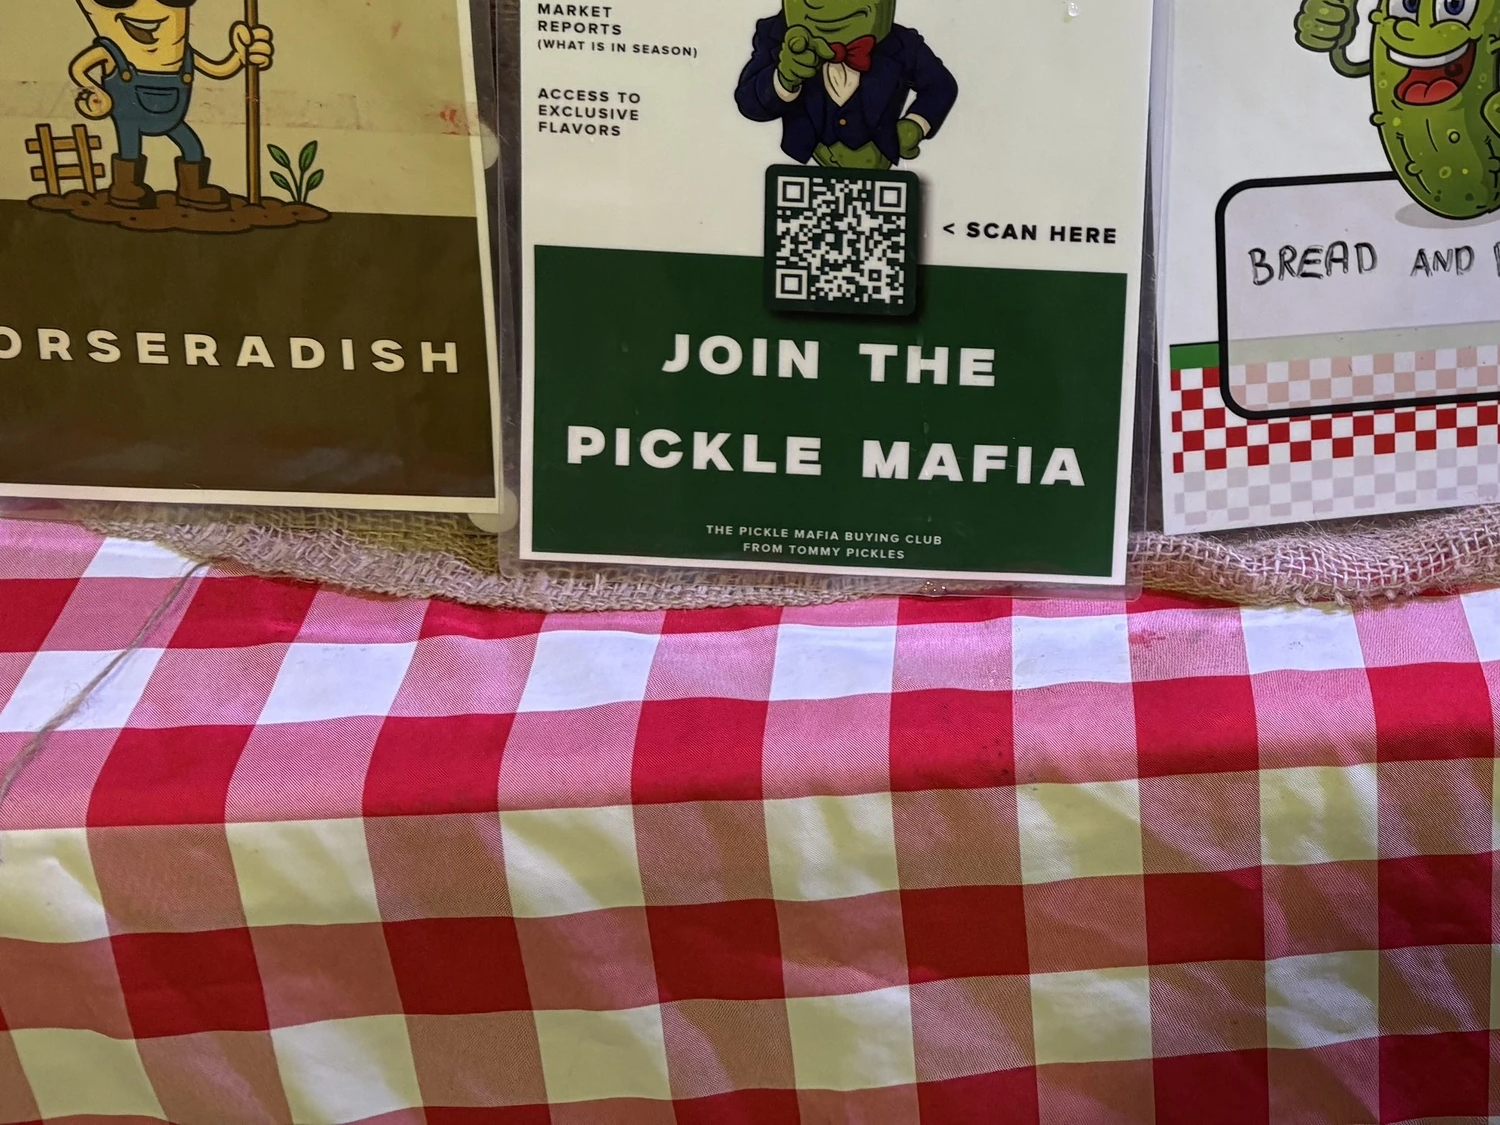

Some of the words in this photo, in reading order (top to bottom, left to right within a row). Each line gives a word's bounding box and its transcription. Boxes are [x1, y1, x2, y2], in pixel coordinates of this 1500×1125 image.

[537, 2, 613, 18] MARKET
[537, 19, 623, 36] REPORTS
[537, 38, 586, 51] (WHAT
[591, 41, 606, 52] IS
[611, 42, 627, 53] IN
[632, 43, 698, 59] SEASON)
[537, 87, 610, 103] ACCESS
[617, 91, 642, 104] TO
[538, 104, 640, 121] EXCLUSIVE
[538, 121, 622, 137] FLAVORS
[966, 221, 1038, 242] SCAN
[1050, 225, 1117, 245] HERE
[1248, 240, 1379, 286] BREAD
[1410, 245, 1476, 277] AND
[661, 333, 820, 379] JOIN
[858, 342, 997, 387] THE
[566, 424, 823, 476] PICKLE
[862, 439, 1086, 487] MAFIA
[706, 524, 734, 536] THE
[739, 525, 789, 539] PICKLE
[794, 528, 840, 542] MAFIA
[844, 531, 900, 544] BUYING
[905, 534, 943, 546] CLUB
[743, 542, 783, 554] FROM
[789, 544, 841, 557] TOMMY
[846, 547, 905, 560] PICKLES
